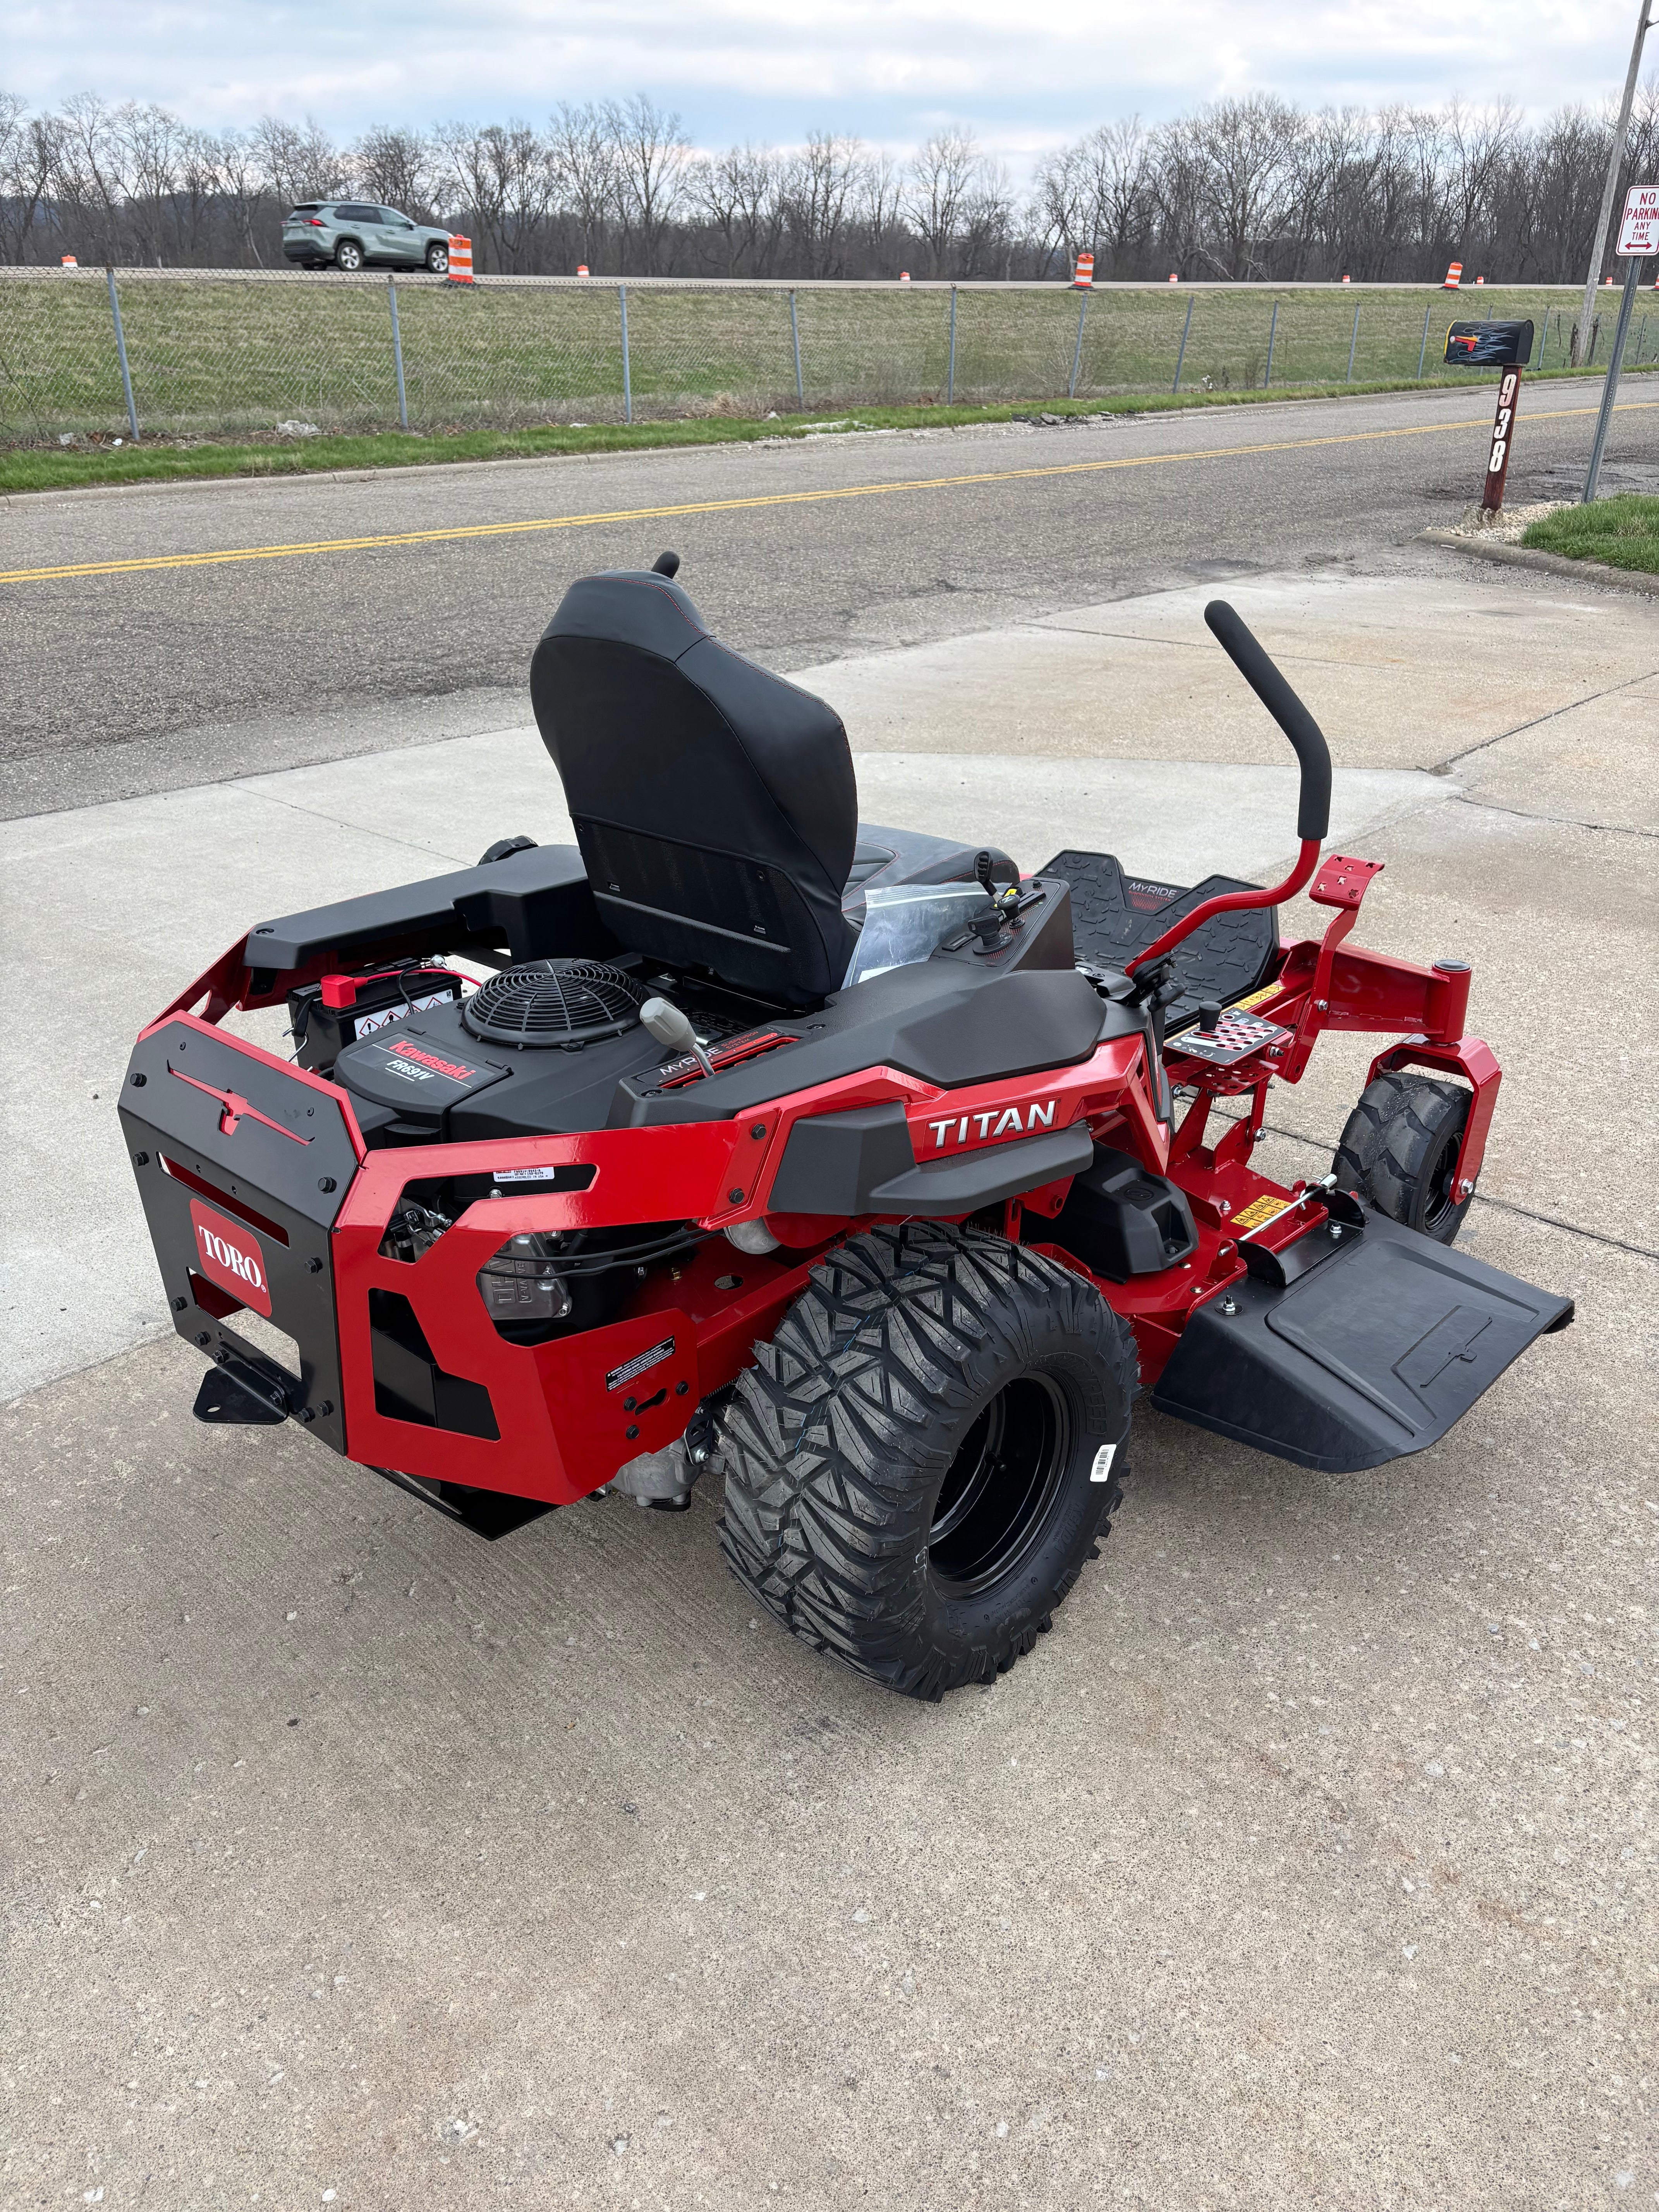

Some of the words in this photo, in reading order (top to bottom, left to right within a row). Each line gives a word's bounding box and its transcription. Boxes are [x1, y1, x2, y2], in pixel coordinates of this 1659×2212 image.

[1640, 192, 1656, 205] NO
[1626, 208, 1659, 220] PARKIN
[1634, 222, 1651, 230] ANY
[1632, 232, 1650, 240] TIME
[1489, 374, 1517, 472] 938
[386, 1060, 434, 1080] FR691V
[389, 1041, 476, 1080] Kawasaki
[659, 1047, 723, 1076] MYRDE
[929, 1100, 1056, 1149] TITAN
[199, 1225, 262, 1287] TORO
[1054, 1501, 1085, 1554] KENDA
